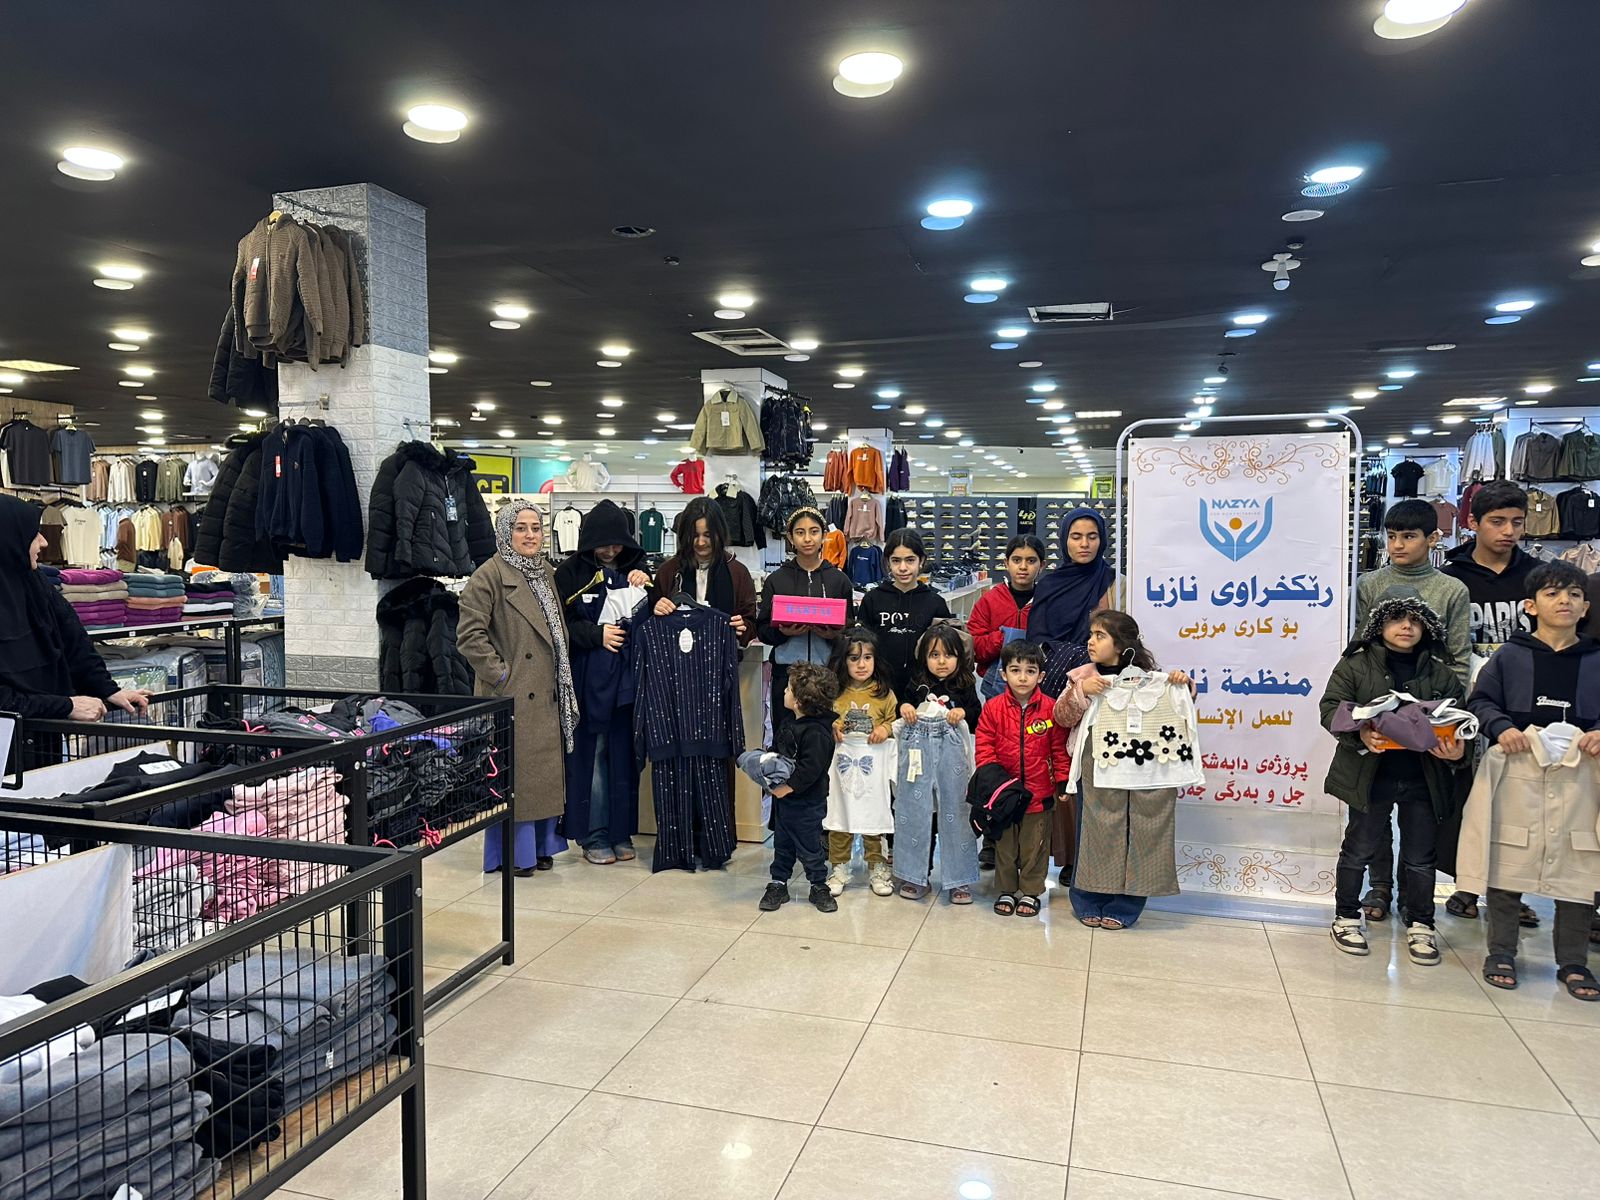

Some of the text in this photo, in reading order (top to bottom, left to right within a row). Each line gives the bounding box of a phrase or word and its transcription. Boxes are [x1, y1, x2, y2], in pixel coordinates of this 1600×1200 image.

[1211, 498, 1260, 510] NAZYA
[1470, 600, 1532, 643] PARIS
[1220, 668, 1313, 697] منظمة
[1196, 707, 1293, 730] للعمل الإنسا
[1201, 752, 1249, 776] دابەشک
[1265, 788, 1275, 803] و
[1282, 785, 1305, 805] جل
